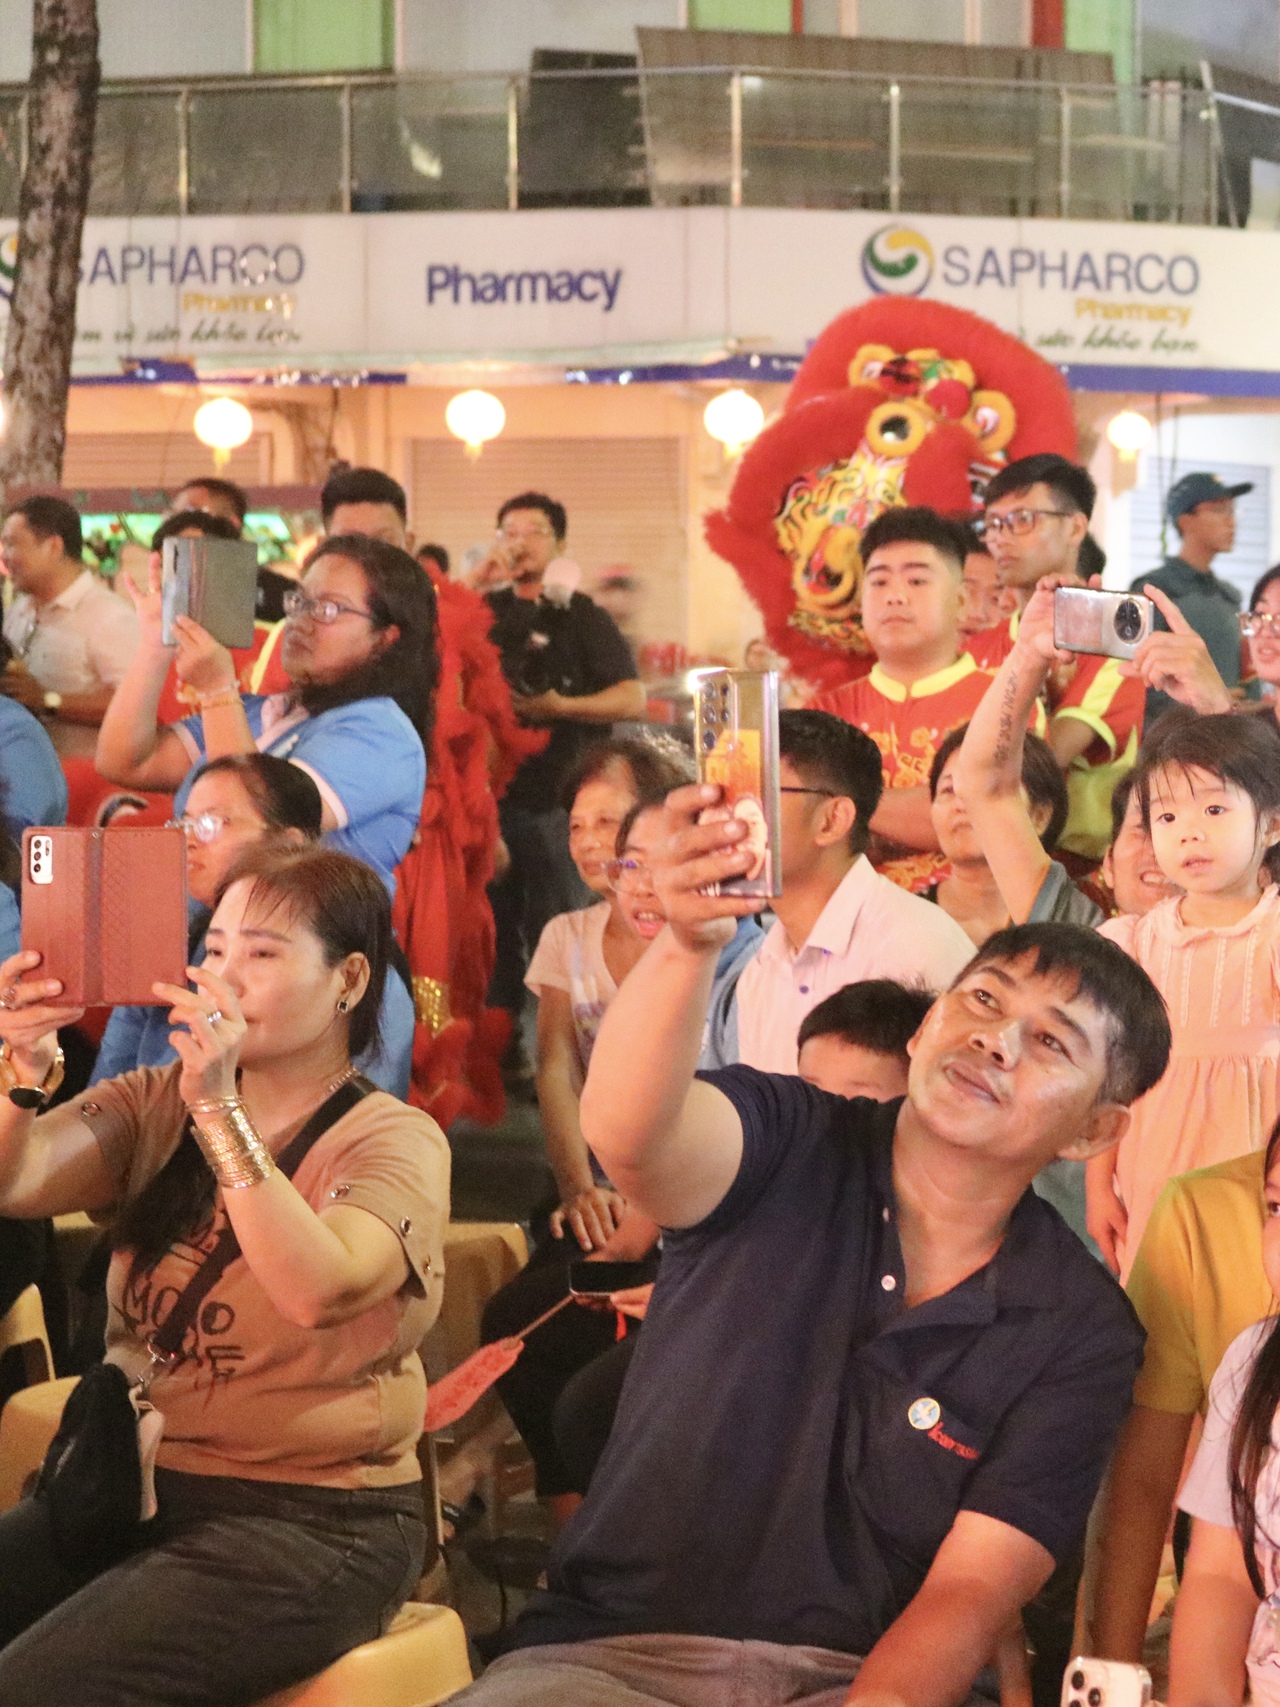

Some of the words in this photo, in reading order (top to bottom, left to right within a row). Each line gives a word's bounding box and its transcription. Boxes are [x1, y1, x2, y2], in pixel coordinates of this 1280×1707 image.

[77, 243, 305, 286] APHARCO
[425, 263, 623, 312] Pharmacy
[942, 244, 1200, 296] SAPHARCO
[1074, 297, 1193, 329] Pharmacy
